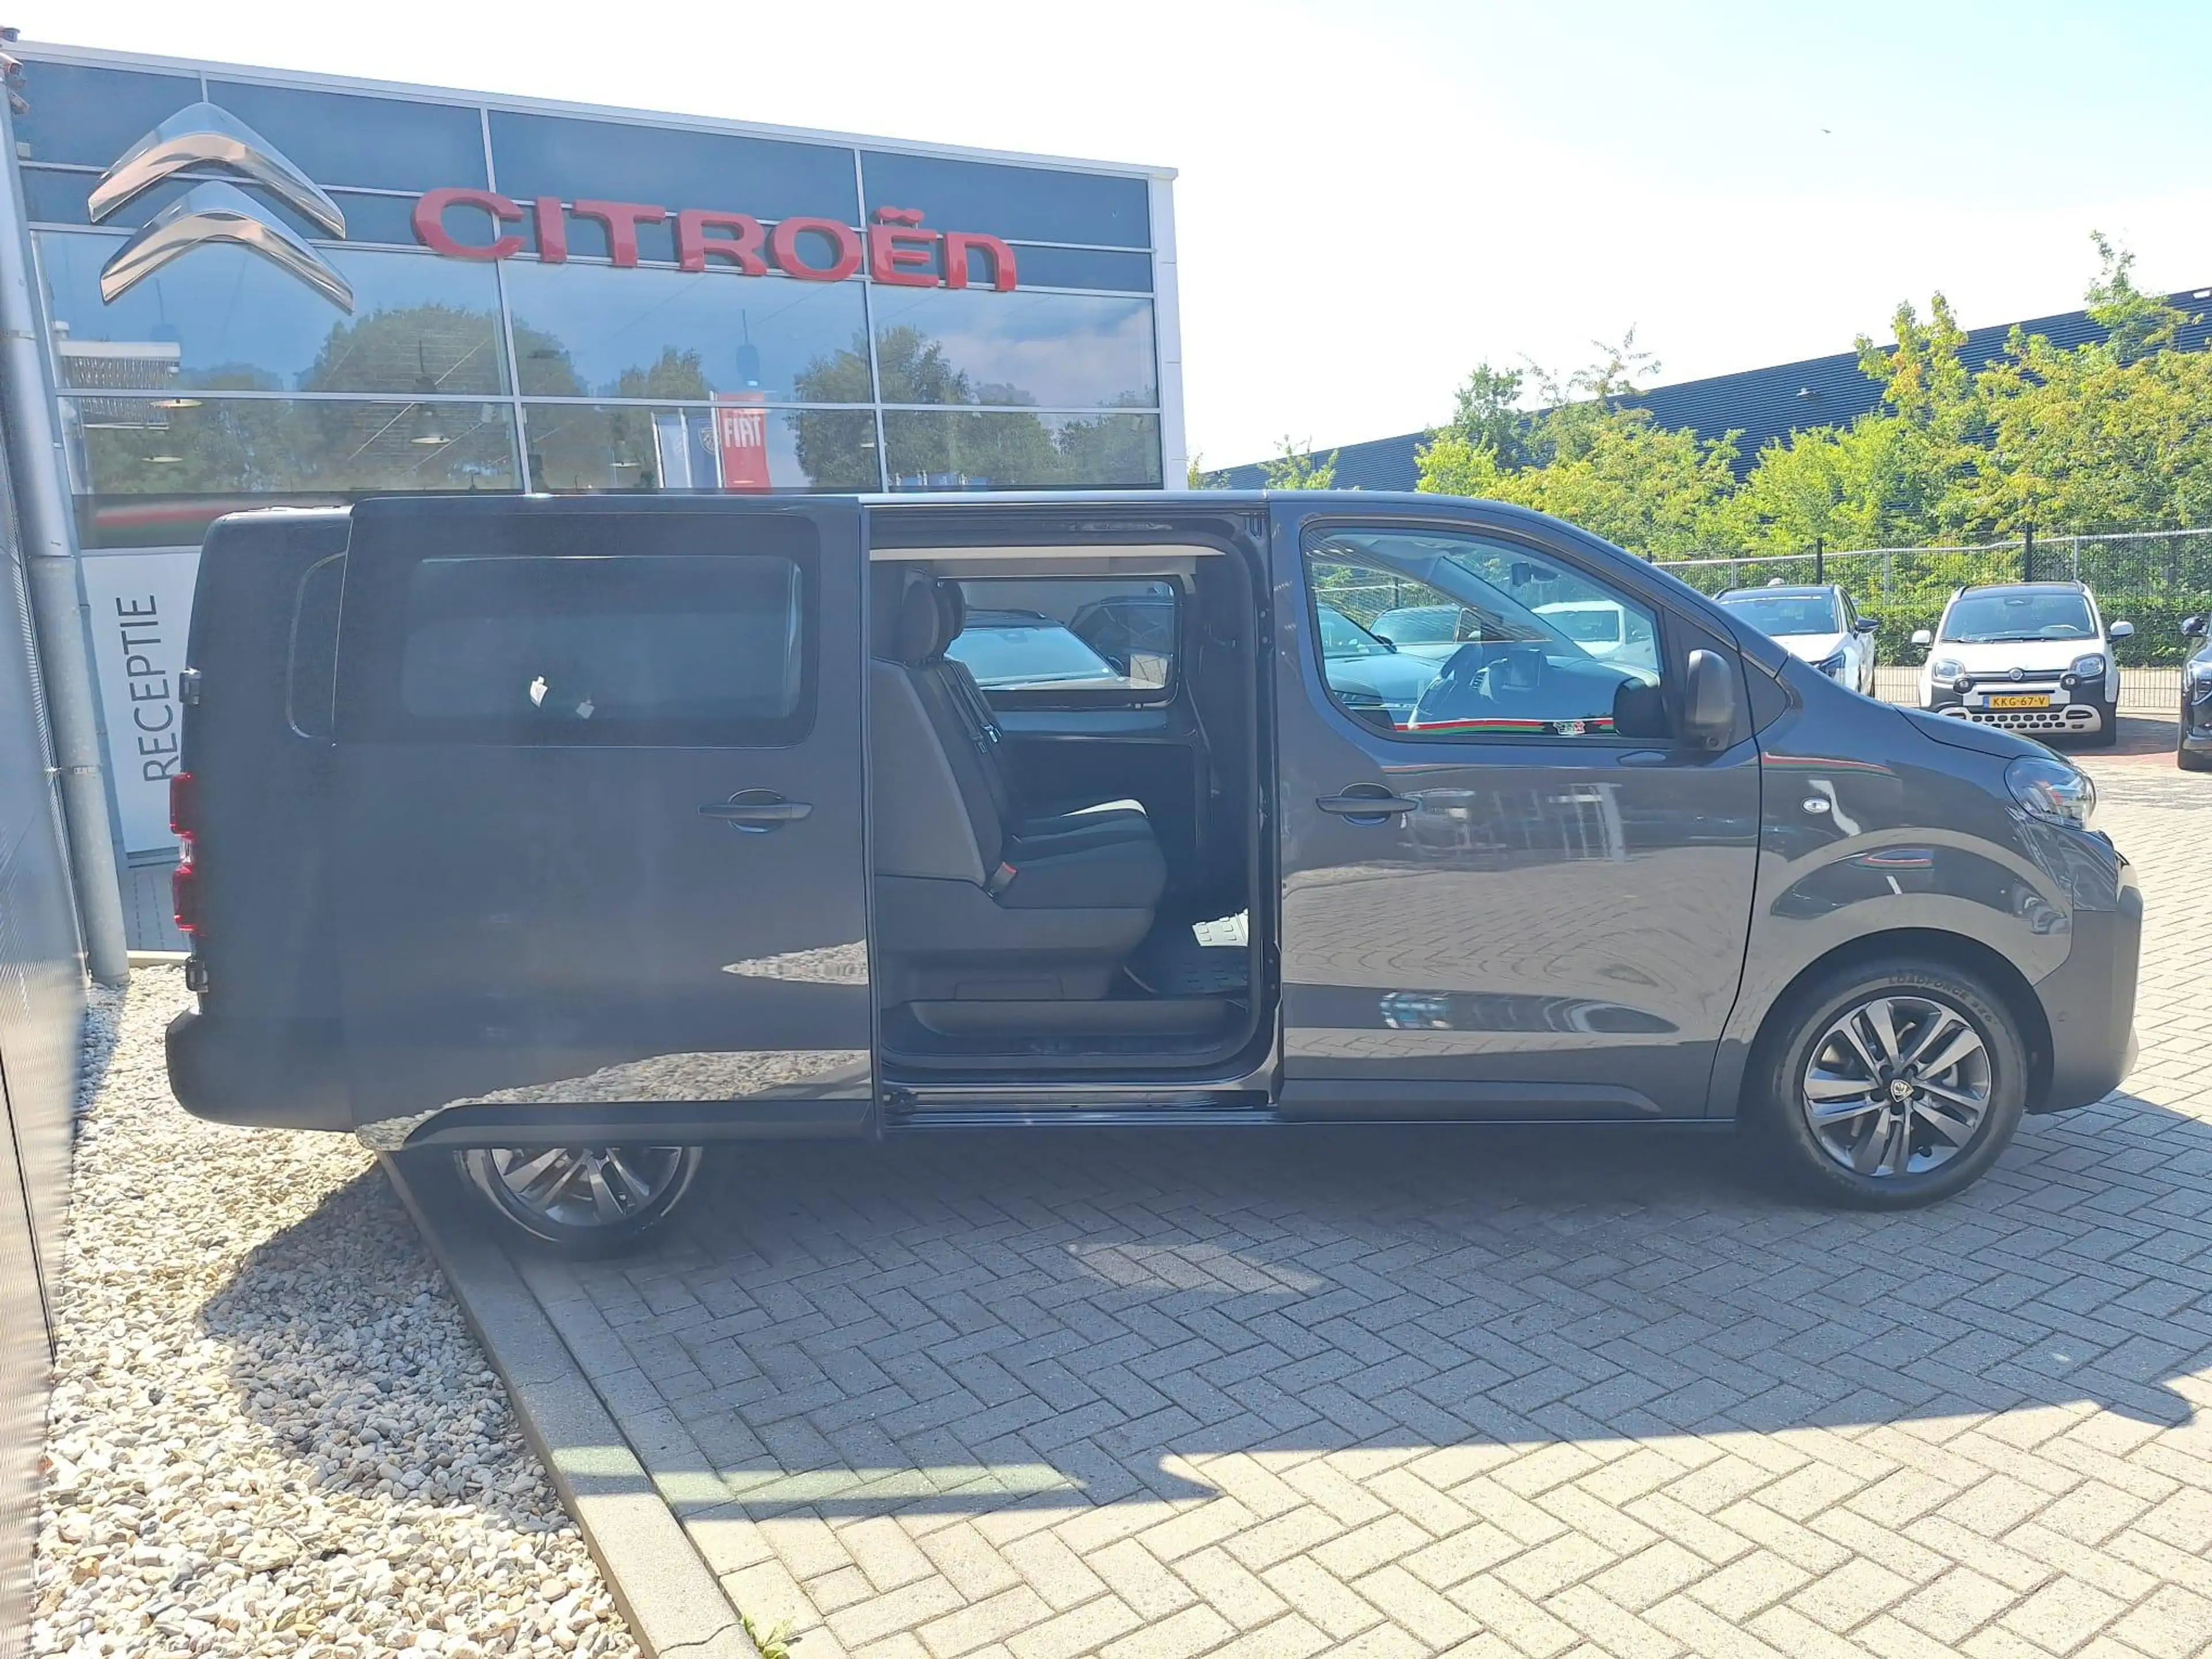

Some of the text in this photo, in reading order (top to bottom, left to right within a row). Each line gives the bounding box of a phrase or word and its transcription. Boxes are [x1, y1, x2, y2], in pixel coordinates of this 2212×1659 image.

[724, 416, 761, 448] FIAT
[116, 593, 179, 781] RECEPTIE
[1993, 696, 2046, 707] KKG-67-V
